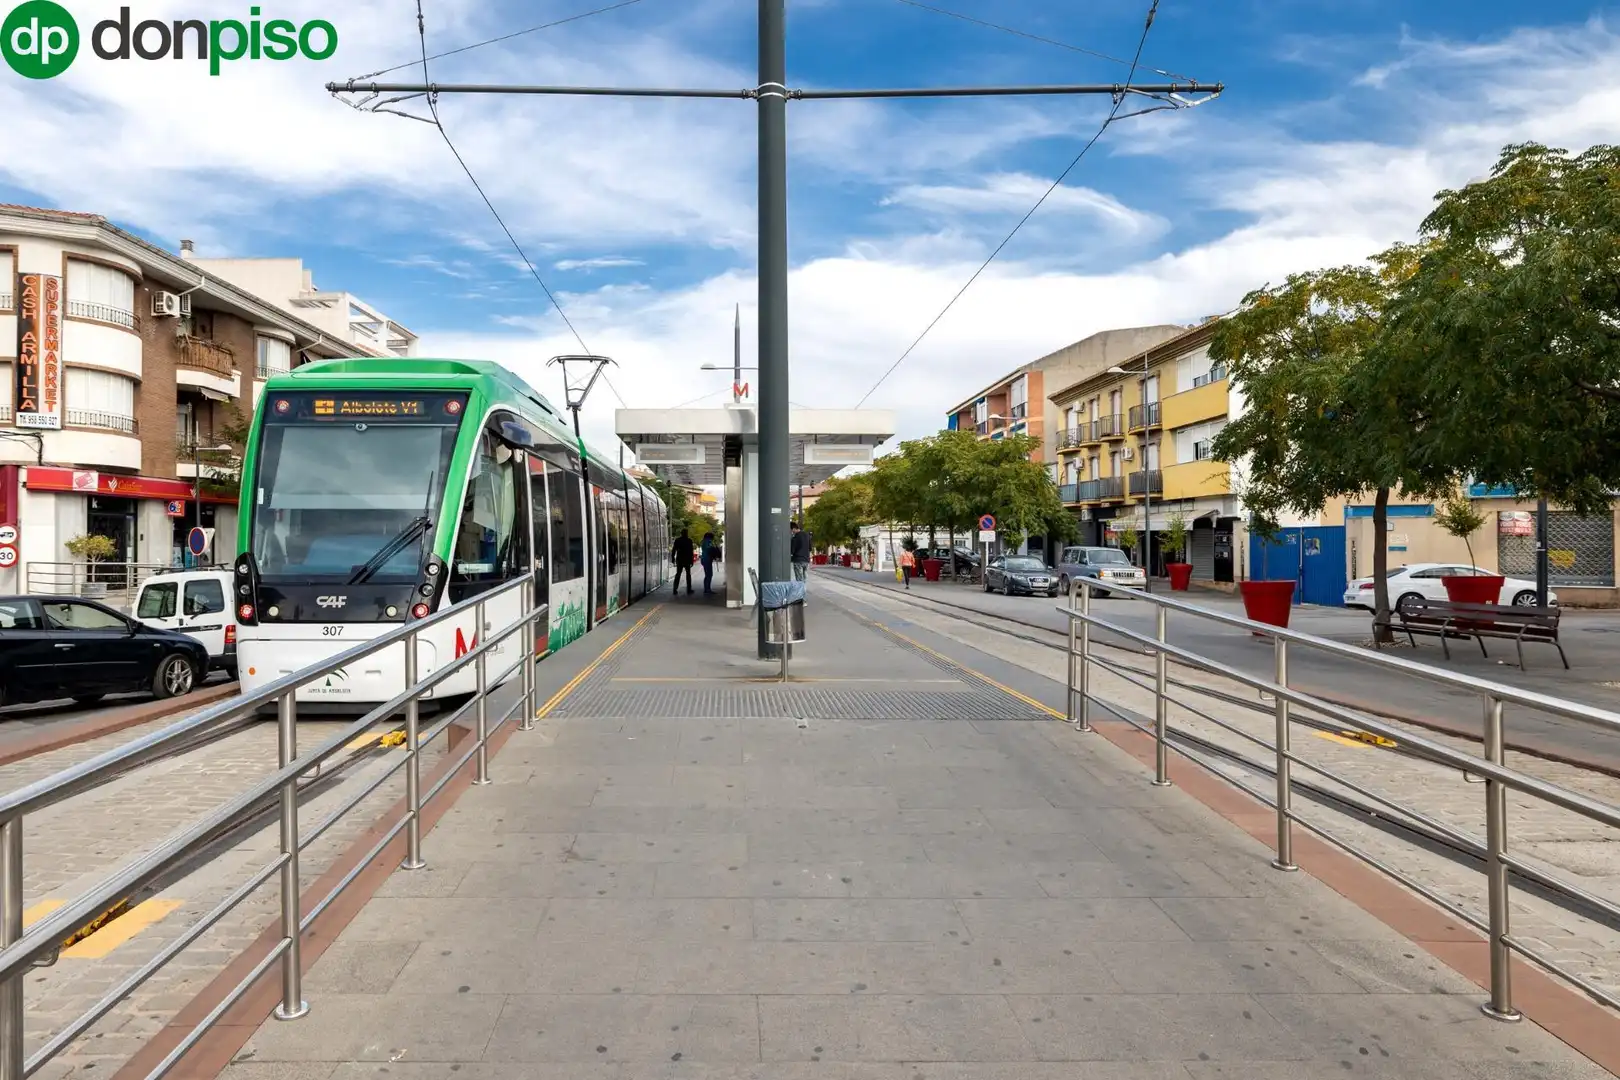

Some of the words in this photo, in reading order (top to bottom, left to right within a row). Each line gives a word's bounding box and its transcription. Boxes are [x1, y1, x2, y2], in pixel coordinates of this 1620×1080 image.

[22, 275, 37, 320] CASH
[44, 277, 59, 413] SUPERMARKET
[20, 331, 38, 410] ARMILLA
[733, 382, 749, 398] M
[0, 552, 14, 561] 30
[316, 595, 348, 608] CAF
[322, 625, 345, 636] 307
